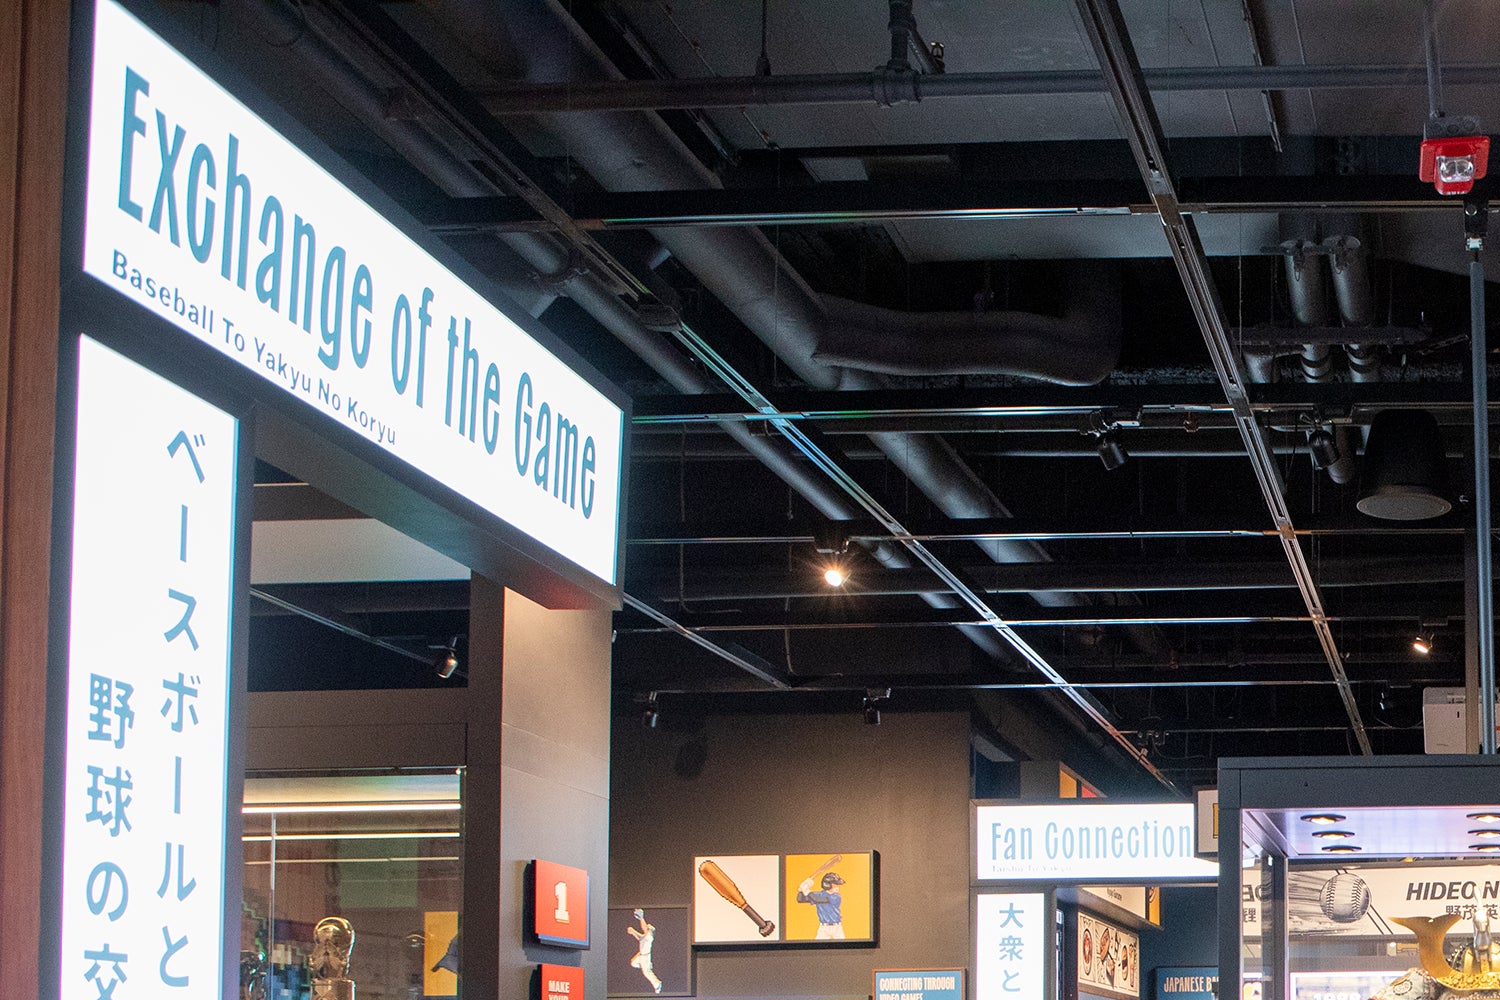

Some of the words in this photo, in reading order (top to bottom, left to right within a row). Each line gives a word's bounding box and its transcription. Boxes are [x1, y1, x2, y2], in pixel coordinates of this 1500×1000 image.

[118, 65, 373, 371] Exchange
[391, 287, 434, 409] of
[444, 315, 500, 455] the
[514, 372, 596, 520] Game
[112, 249, 213, 335] Baseball
[222, 317, 246, 353] To
[254, 335, 311, 395] Yakyu
[318, 382, 341, 412] No
[348, 400, 396, 447] Koryu
[157, 430, 206, 988] ベースボールと
[992, 823, 1032, 860] Fan
[1045, 820, 1191, 860] Connection
[554, 881, 569, 922] 1
[1406, 881, 1478, 902] HIDEO
[548, 980, 570, 994] MAKE
[879, 977, 922, 991] CONNECTING
[923, 976, 955, 990] THROUGH
[1164, 977, 1204, 992] JAPANESE
